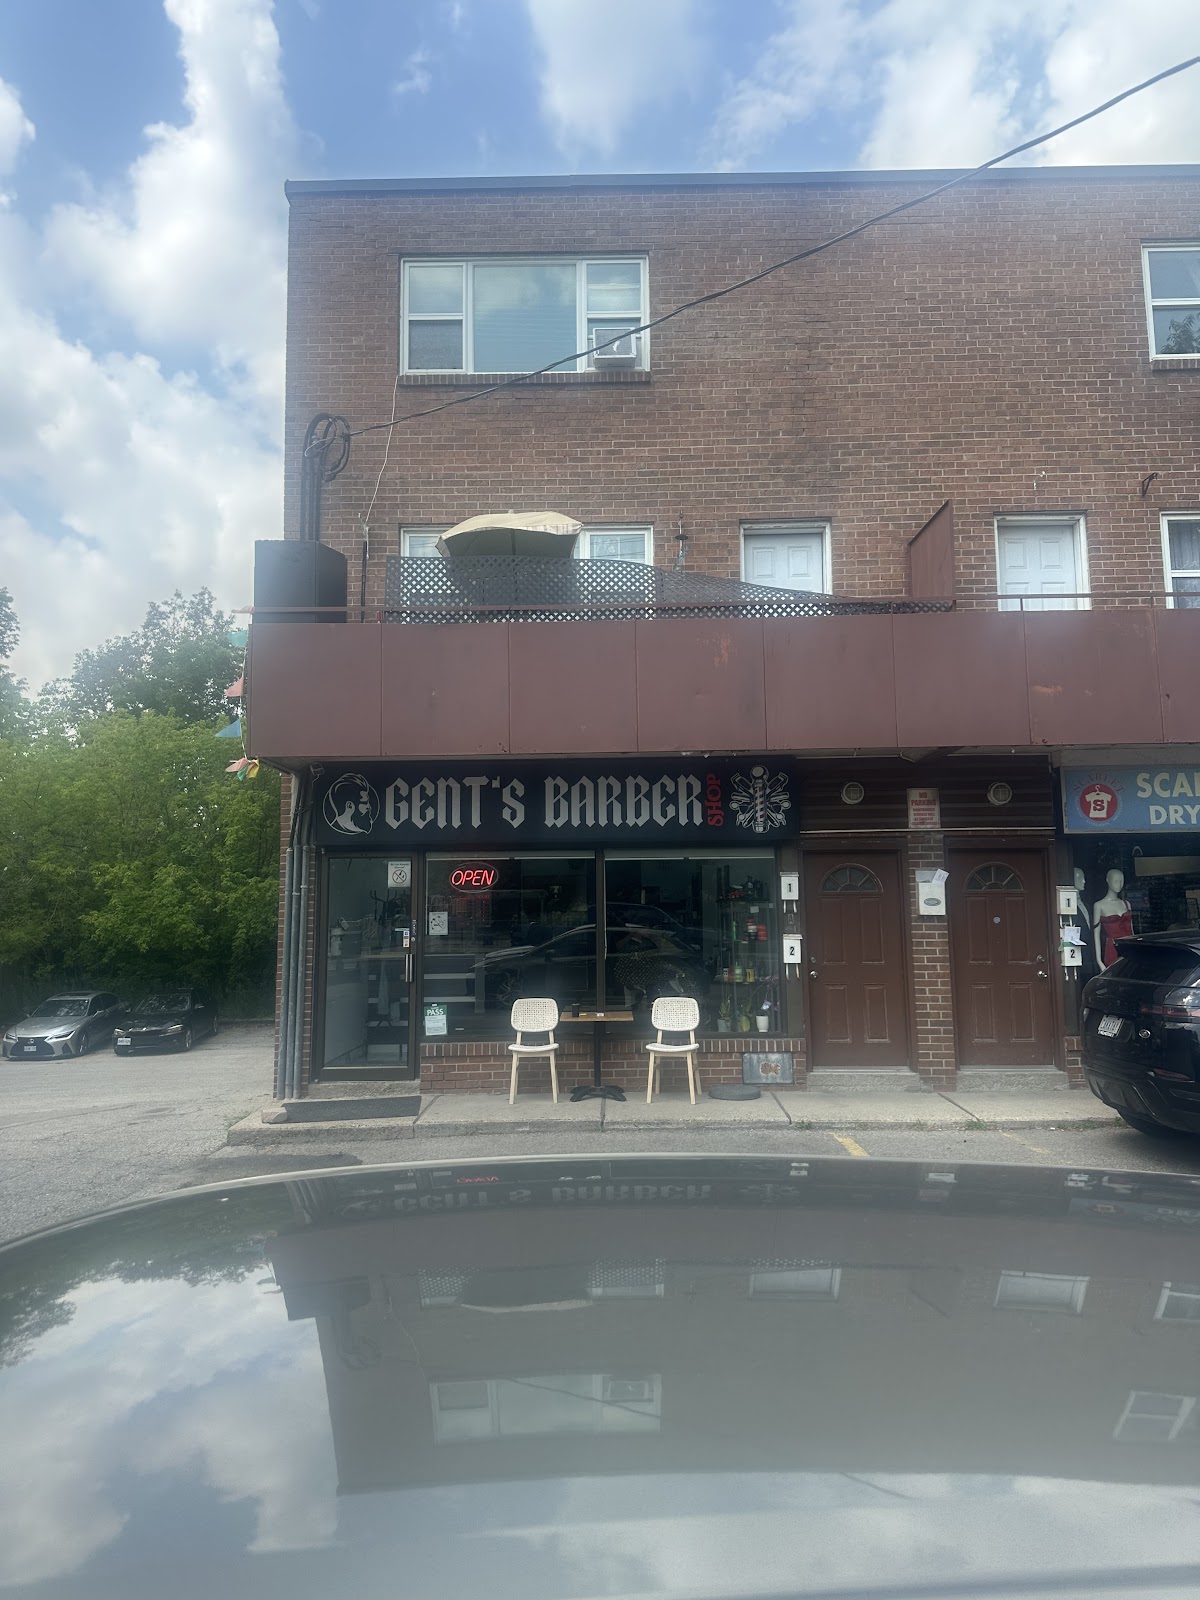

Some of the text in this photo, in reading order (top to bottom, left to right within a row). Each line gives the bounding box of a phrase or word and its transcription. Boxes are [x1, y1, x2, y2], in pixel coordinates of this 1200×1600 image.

[385, 774, 704, 830] GENT'S BARBER
[705, 773, 724, 827] SHOP
[1092, 799, 1105, 811] S
[1149, 804, 1200, 825] DRY
[451, 870, 494, 885] OPEN
[789, 946, 795, 956] 2
[1070, 949, 1075, 958] 2
[426, 1008, 444, 1016] PASS
